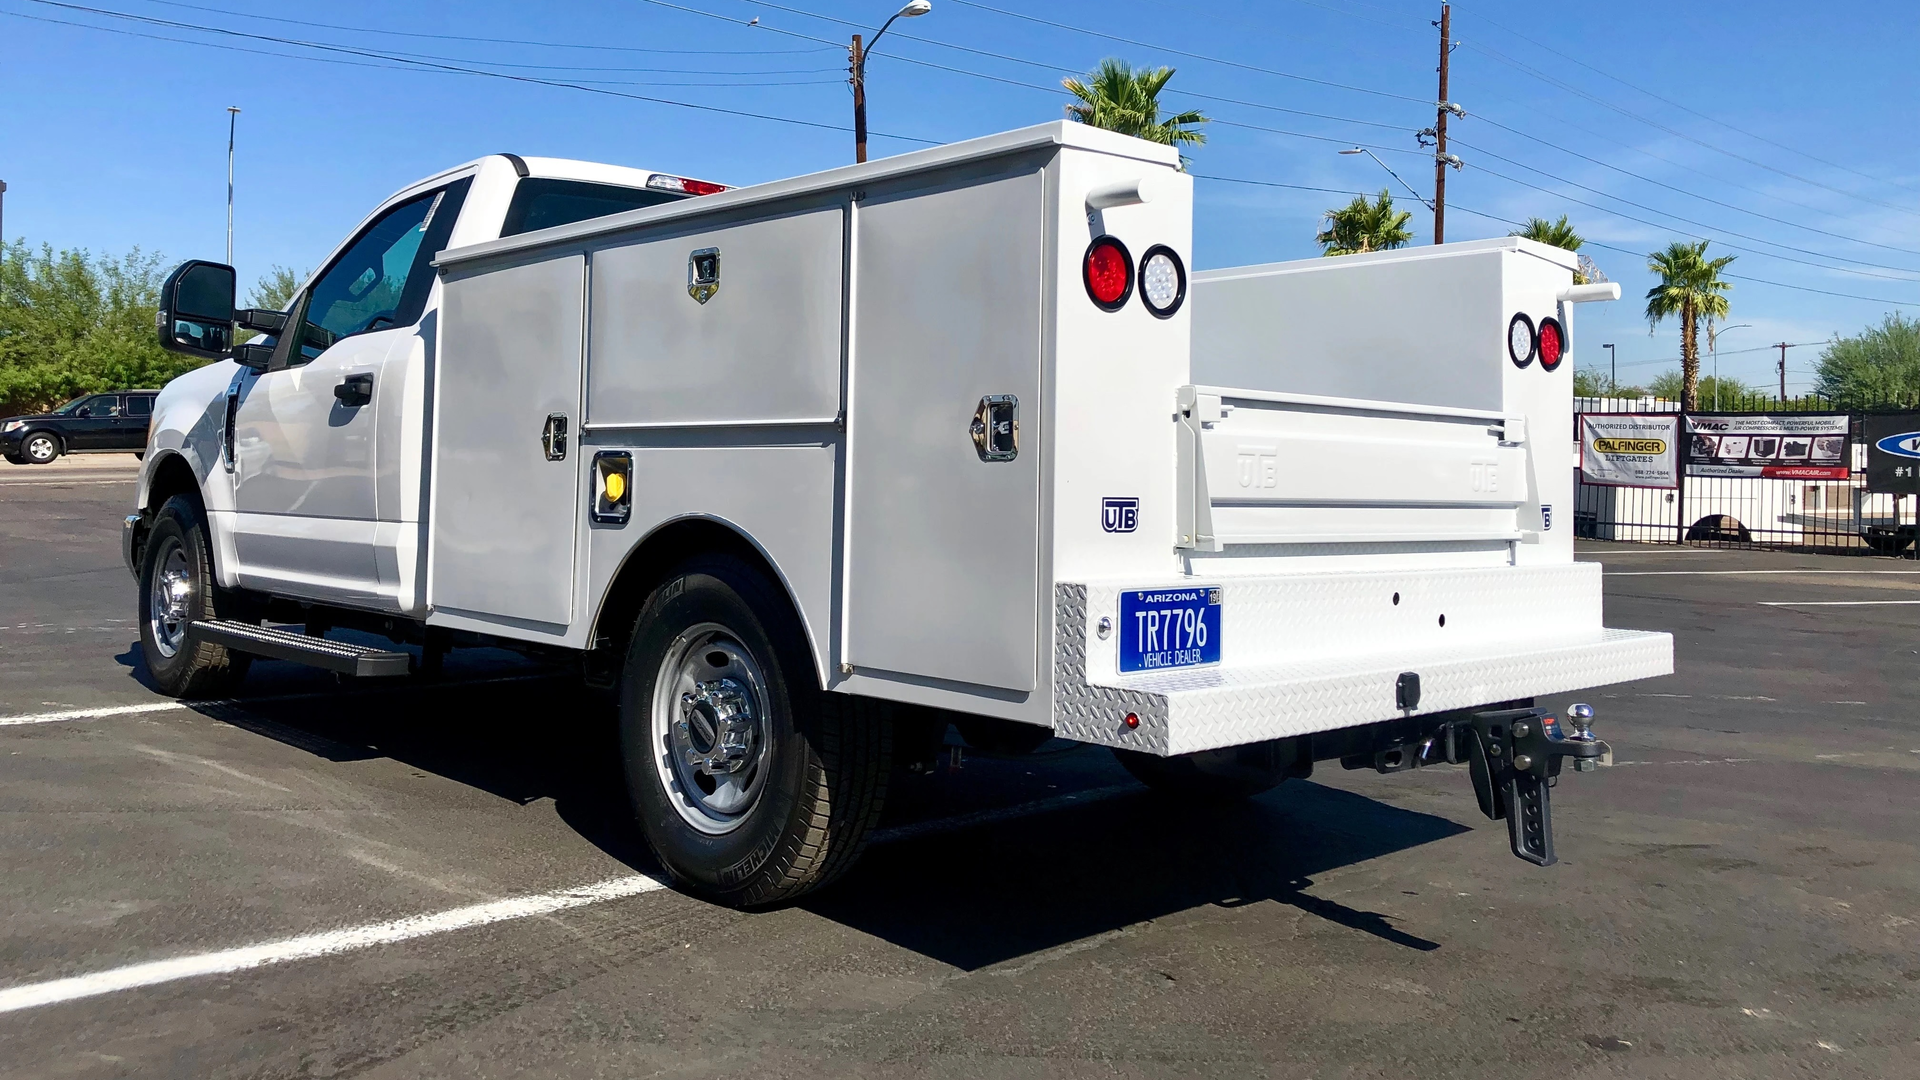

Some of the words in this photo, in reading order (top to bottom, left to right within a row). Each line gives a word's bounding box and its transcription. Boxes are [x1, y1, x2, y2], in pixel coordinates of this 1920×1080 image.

[1692, 422, 1729, 431] VMAC
[1598, 440, 1661, 452] PALFINGER
[1605, 454, 1654, 463] LIFTGATES
[1104, 499, 1137, 530] UTB
[1145, 592, 1198, 603] ARIZONA
[1135, 607, 1208, 653] TR7796
[1143, 651, 1172, 668] VEHICLE
[1174, 648, 1202, 665] DEALER
